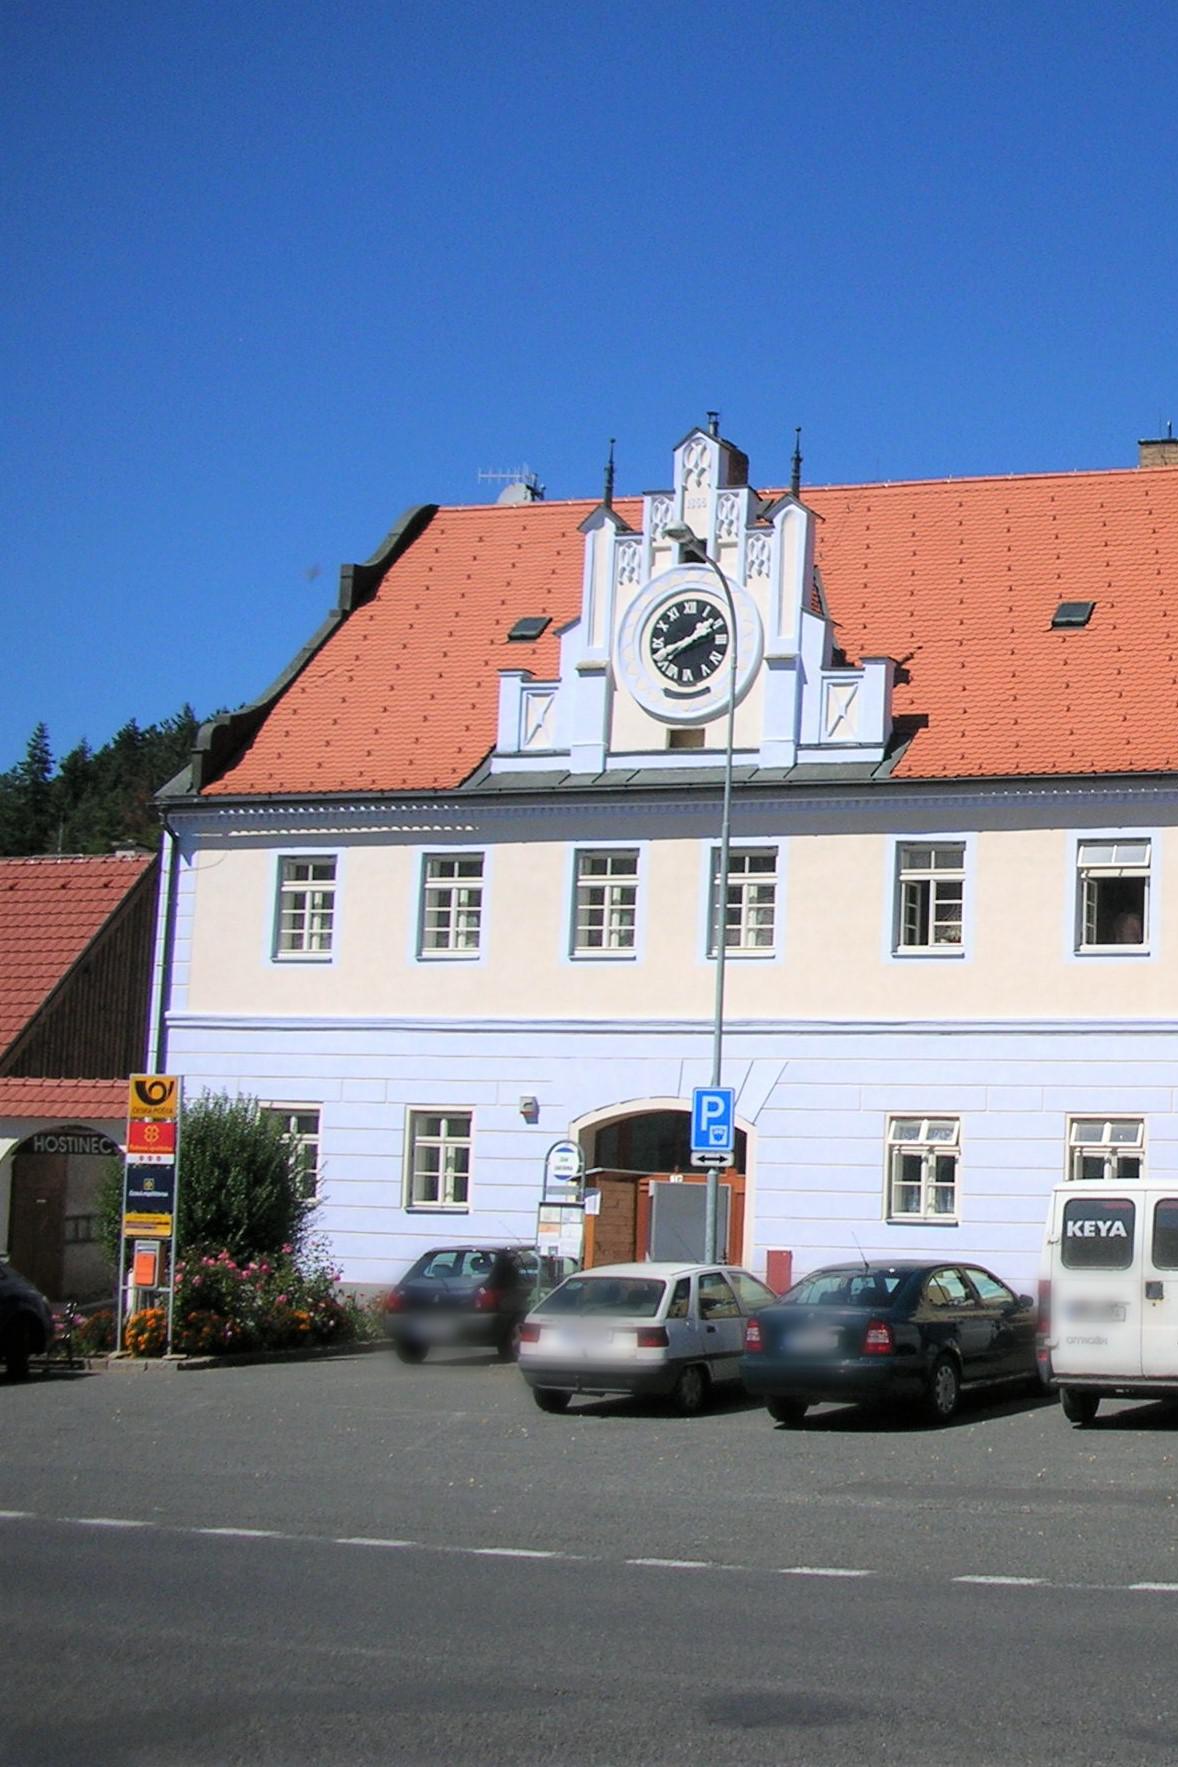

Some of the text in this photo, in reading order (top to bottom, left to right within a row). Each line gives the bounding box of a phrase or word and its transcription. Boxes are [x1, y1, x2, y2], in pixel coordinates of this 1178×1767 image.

[701, 1095, 725, 1131] P
[34, 1136, 112, 1153] HOSTINEC
[1066, 1220, 1127, 1238] KEYA
